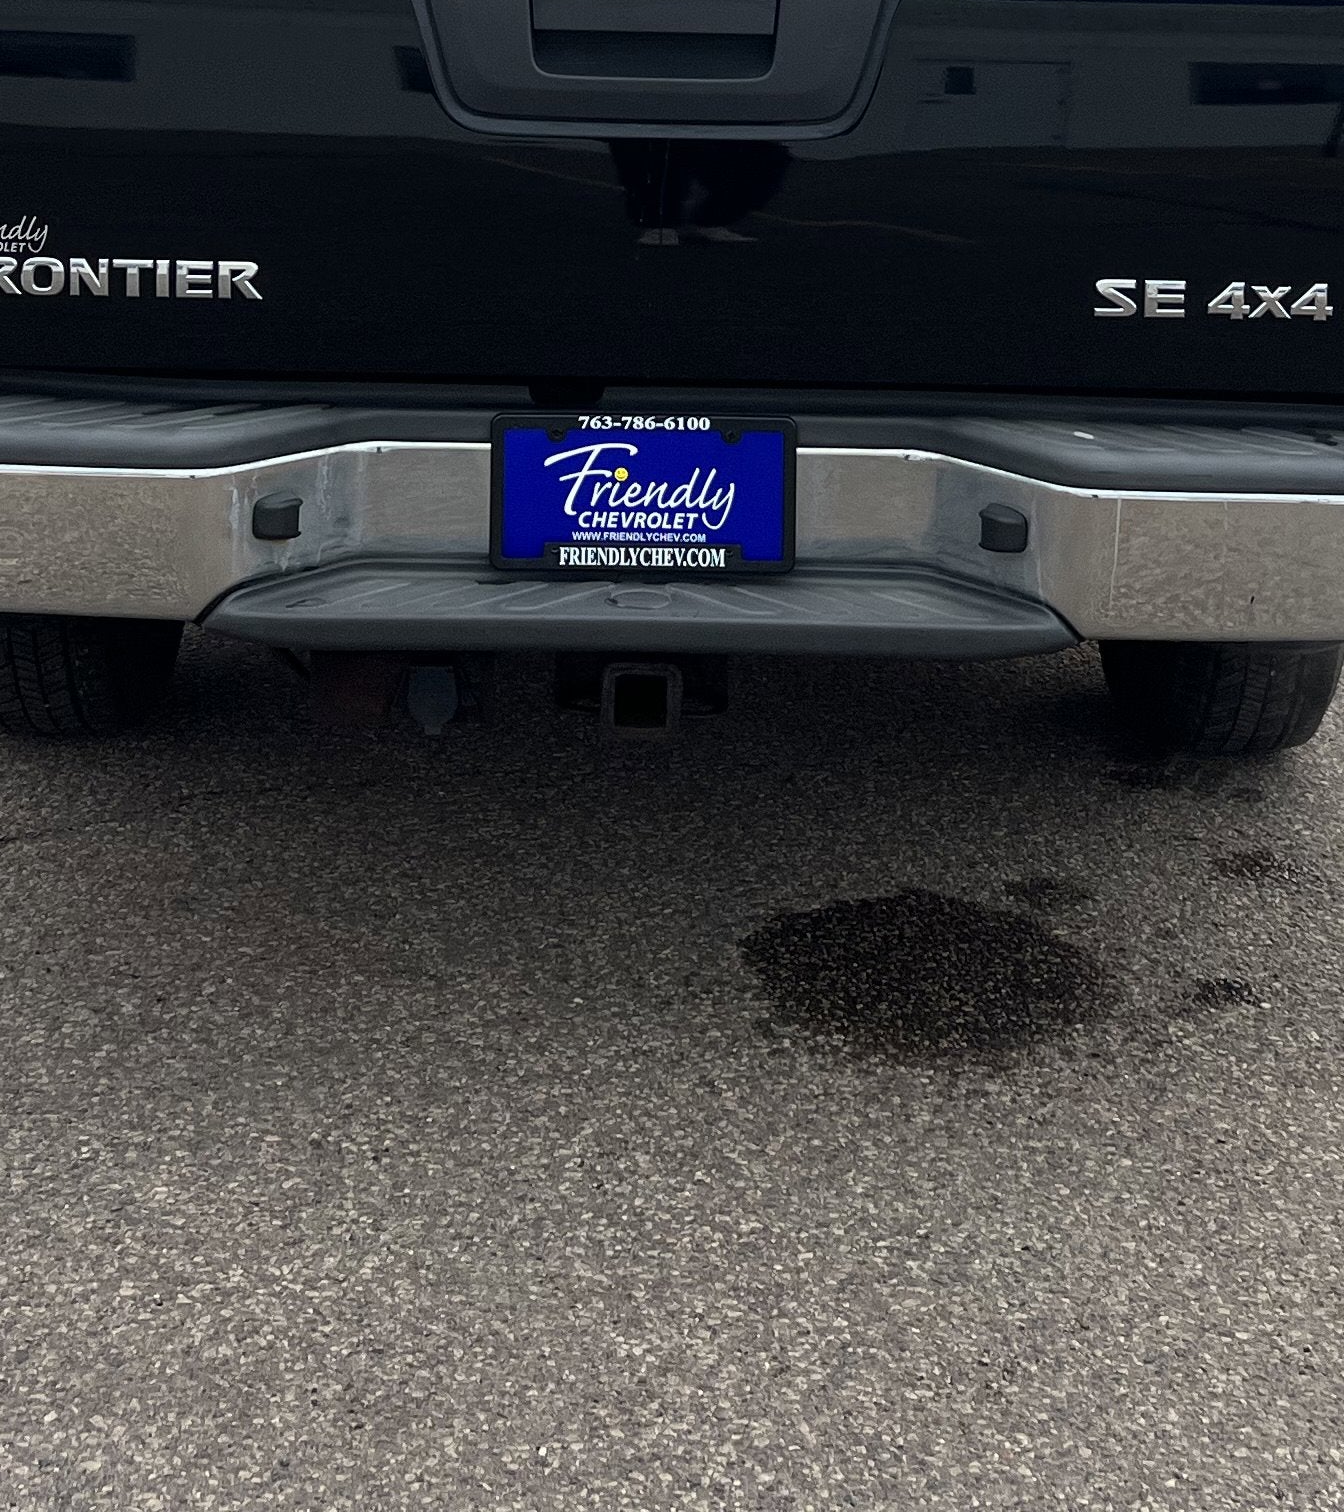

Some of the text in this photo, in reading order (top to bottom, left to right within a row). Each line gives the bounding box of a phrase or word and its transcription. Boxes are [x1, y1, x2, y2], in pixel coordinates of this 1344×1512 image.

[1093, 278, 1333, 320] SE 4x4
[577, 415, 711, 431] 763-786-6100
[544, 442, 735, 530] Friendly
[578, 511, 700, 530] CHEVROLET
[571, 531, 707, 543] WWW.FRIENDLYCHEV.COM
[559, 546, 726, 568] FRIENDLYCHEV.COM
